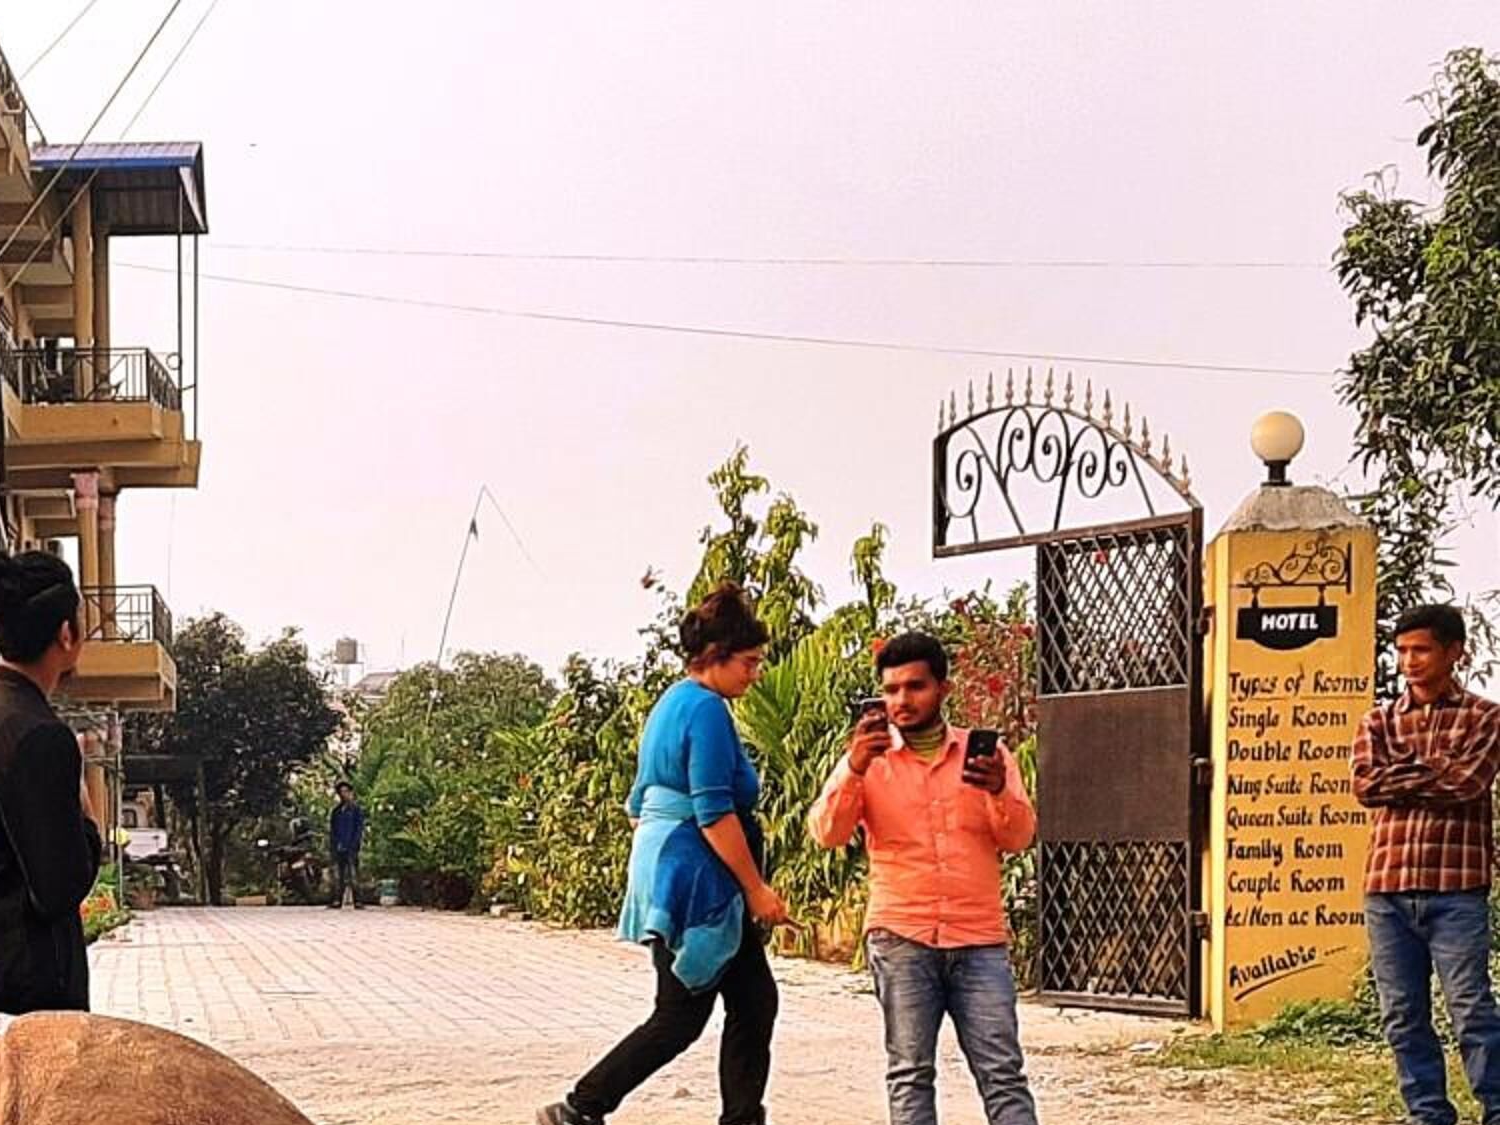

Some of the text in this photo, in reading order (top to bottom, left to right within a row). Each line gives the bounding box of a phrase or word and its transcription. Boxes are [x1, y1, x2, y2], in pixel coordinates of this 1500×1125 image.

[1260, 612, 1319, 632] HOTEL
[1229, 665, 1369, 702] Types of Rooms
[1227, 705, 1348, 738] Single Room
[1227, 739, 1351, 762] Double Room
[1227, 773, 1262, 802] King
[1265, 773, 1303, 795] Suite
[1227, 803, 1367, 831] Queen Suite Room
[1226, 836, 1344, 867] Family Room
[1227, 869, 1345, 901] Couple Room
[1288, 910, 1310, 927] ac
[1315, 903, 1365, 927] Room
